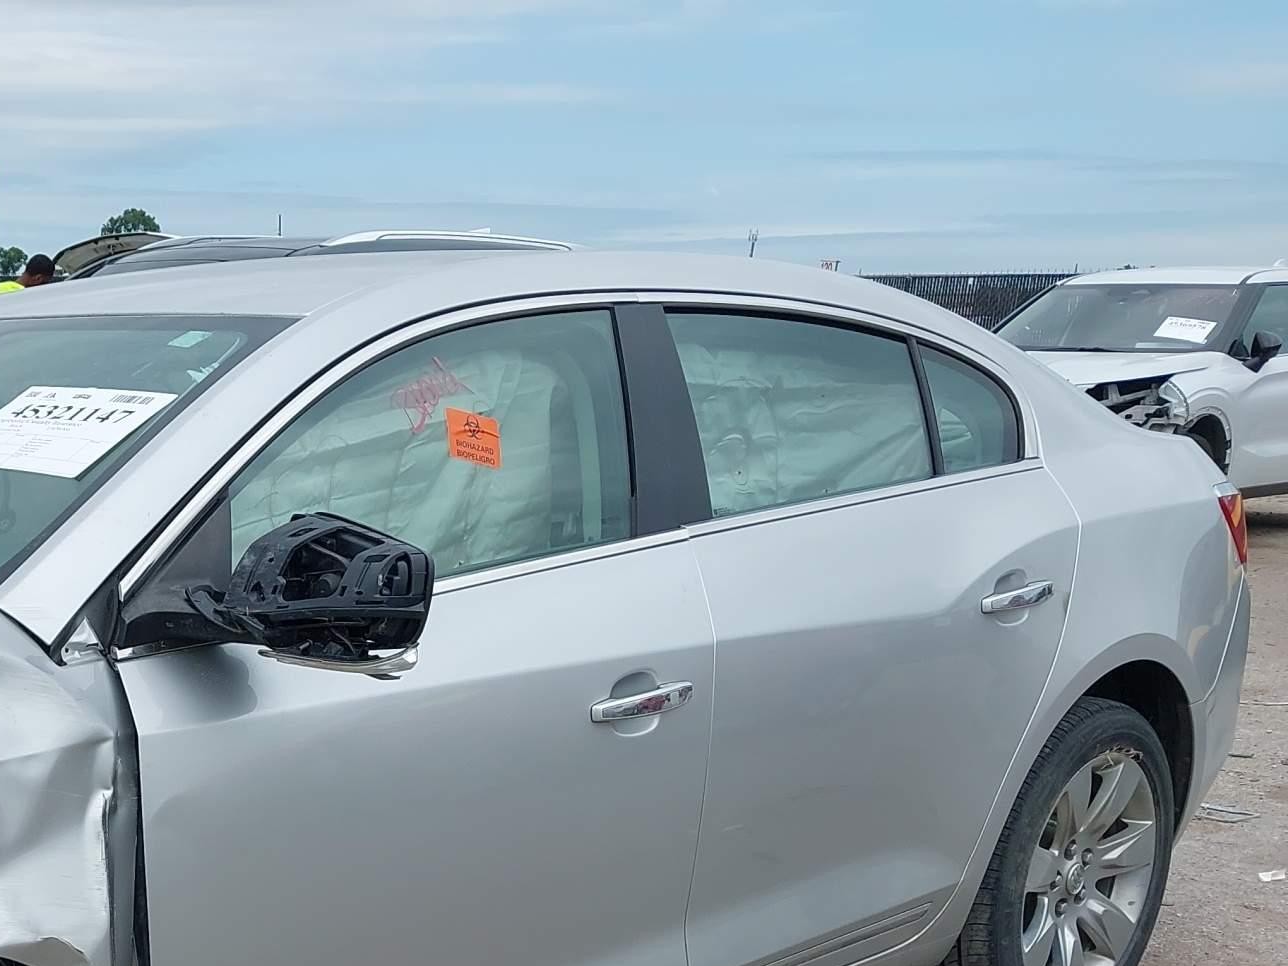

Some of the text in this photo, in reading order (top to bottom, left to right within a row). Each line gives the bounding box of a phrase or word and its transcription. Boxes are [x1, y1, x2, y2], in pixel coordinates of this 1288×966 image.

[11, 403, 135, 424] 45321147
[455, 439, 494, 456] BIOHAZARD
[456, 448, 496, 465] BIOPELIGRO
